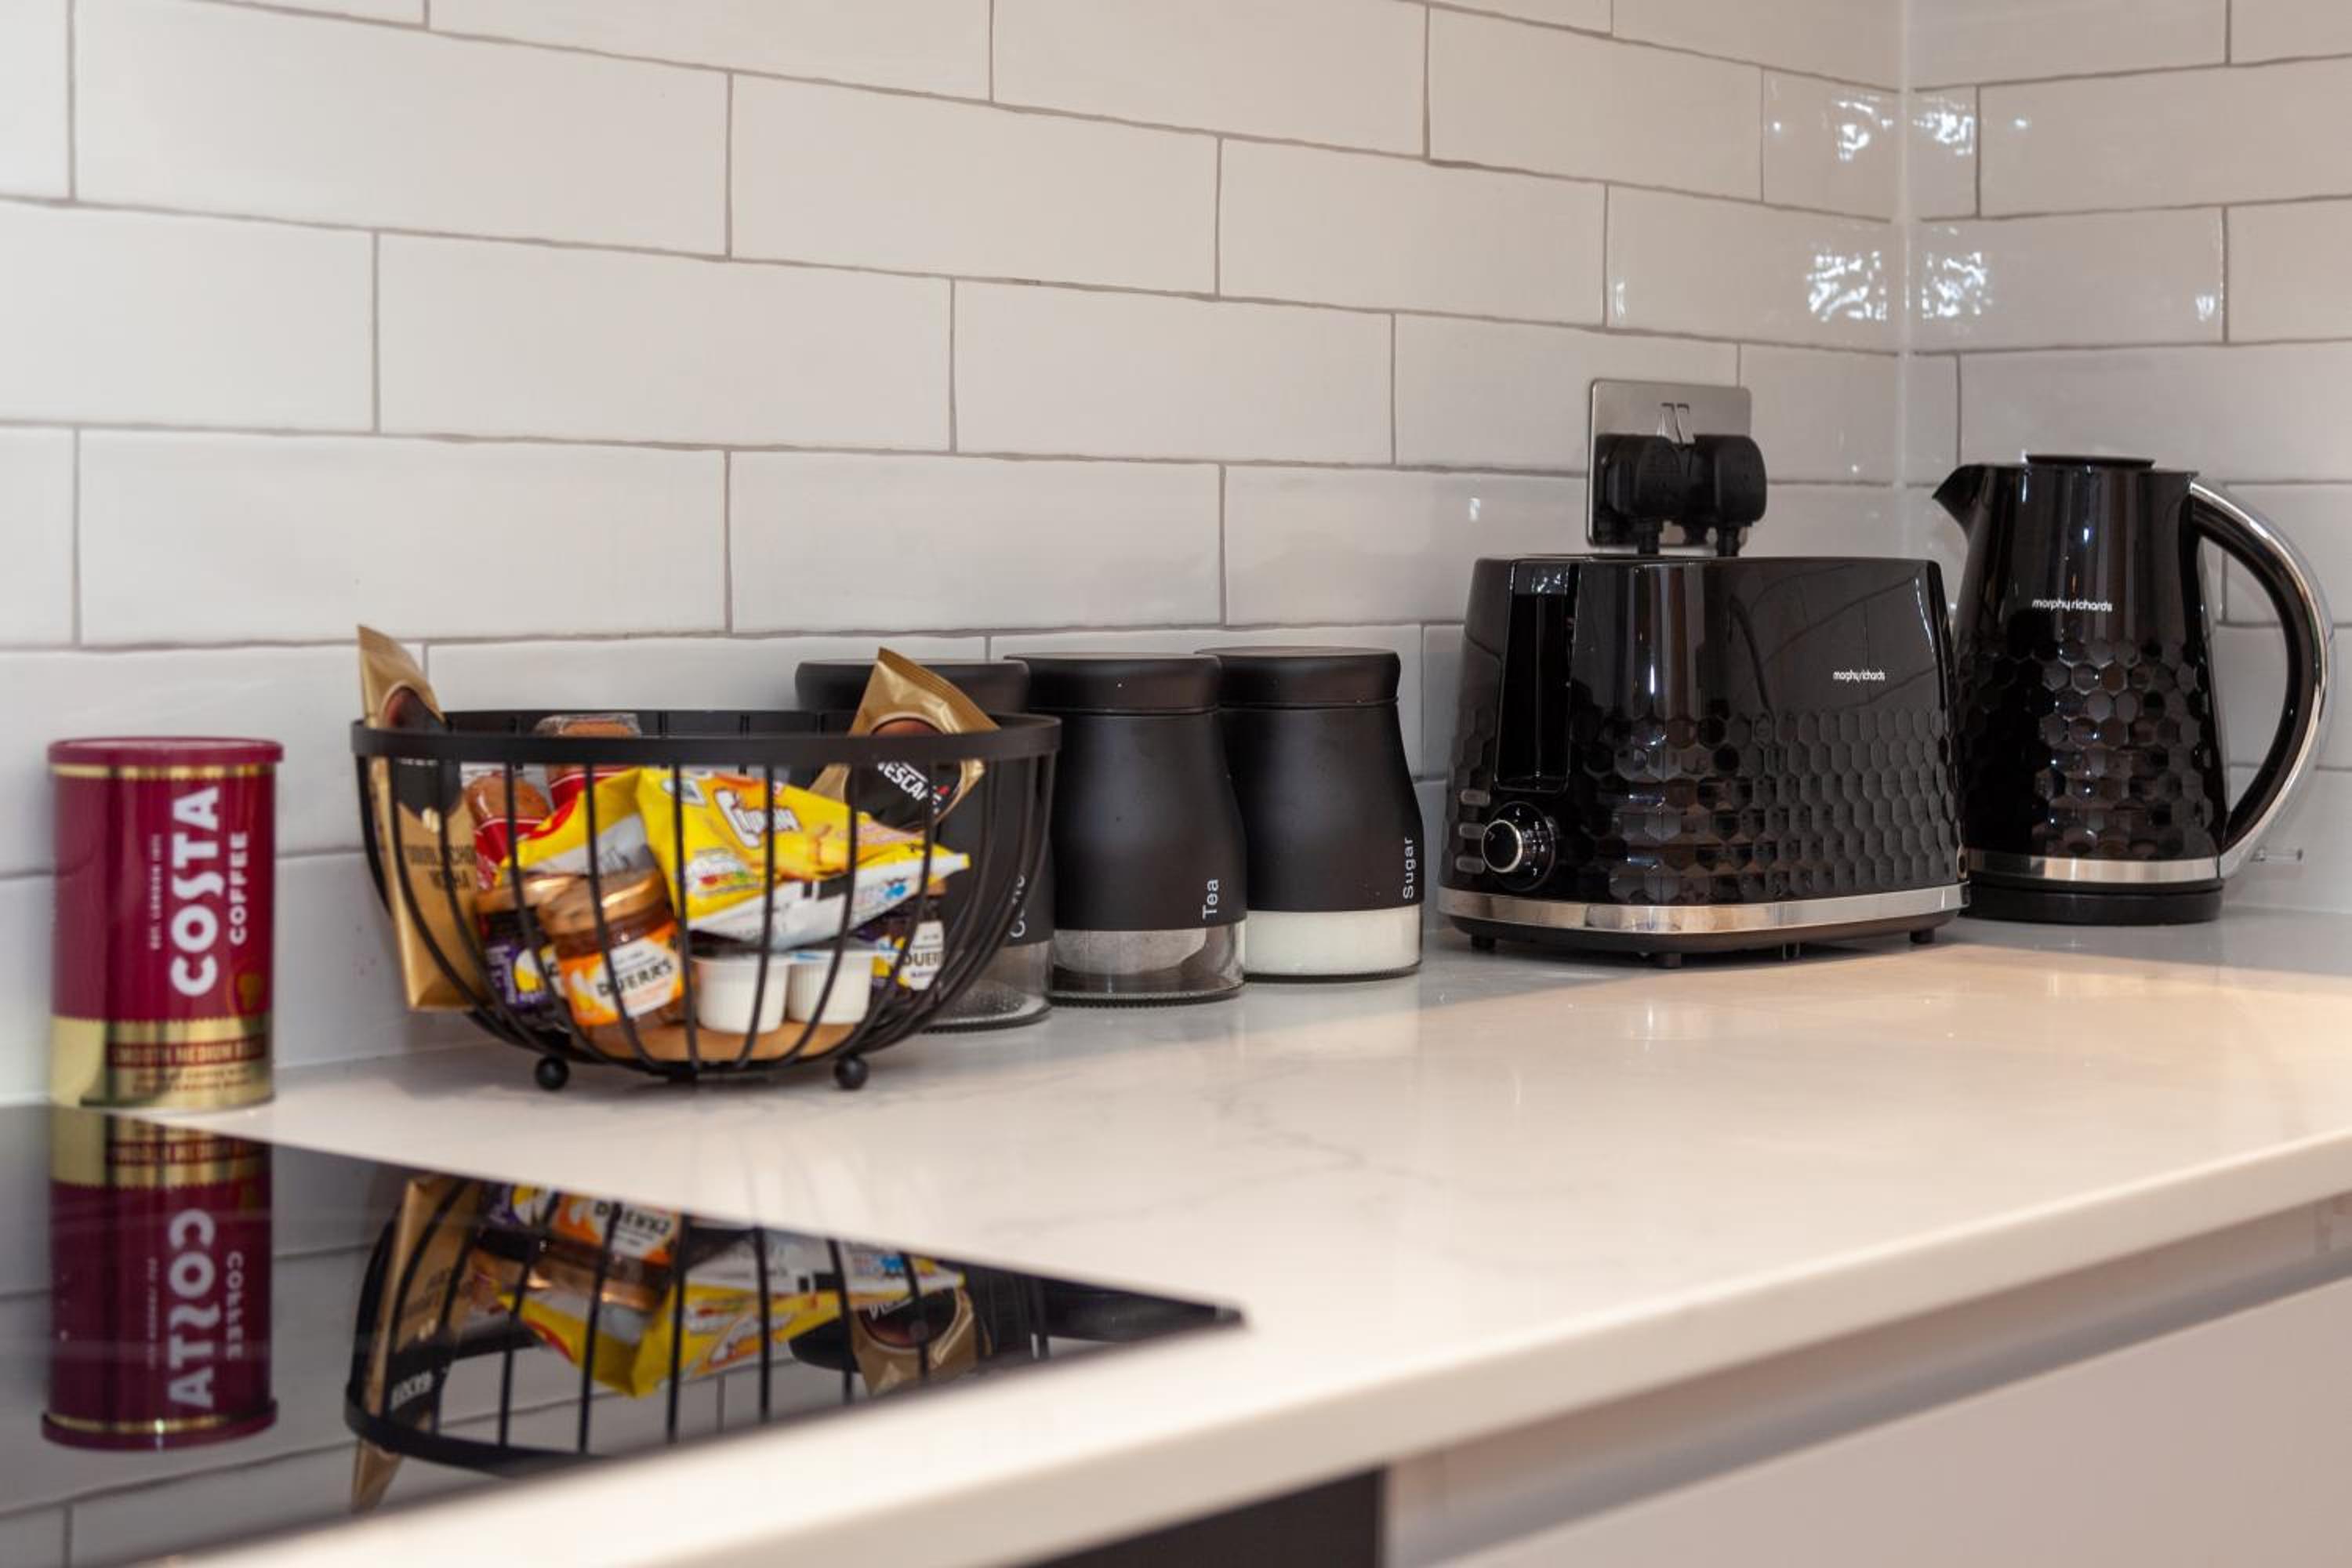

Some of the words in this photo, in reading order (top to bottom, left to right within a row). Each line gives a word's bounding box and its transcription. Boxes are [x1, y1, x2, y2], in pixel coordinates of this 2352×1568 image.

[2032, 597, 2070, 612] morphy
[2071, 598, 2113, 612] richards
[169, 786, 225, 997] COSTA
[229, 832, 248, 946] COFFEE
[1403, 837, 1417, 899] Sugar
[1202, 879, 1218, 920] Tea
